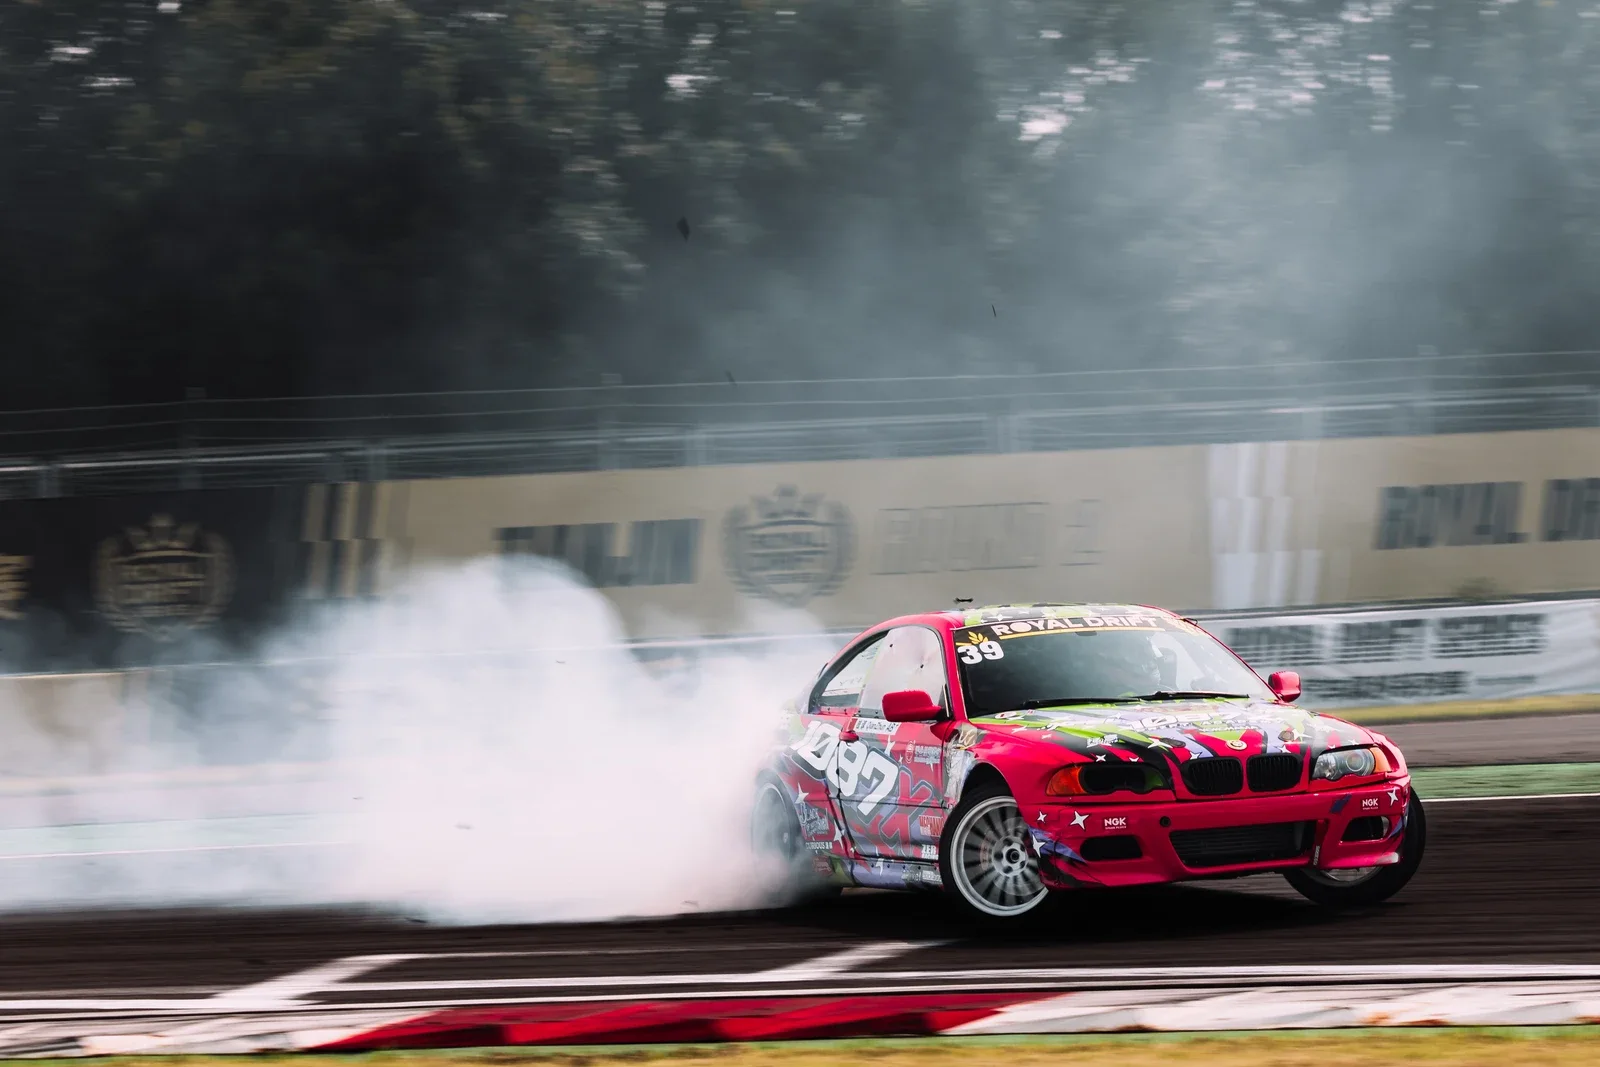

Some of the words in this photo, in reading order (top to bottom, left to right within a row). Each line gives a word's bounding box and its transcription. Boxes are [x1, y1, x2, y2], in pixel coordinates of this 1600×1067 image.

[991, 617, 1084, 636] ROYAL
[1087, 615, 1158, 629] DRIFT
[957, 640, 1004, 665] 39
[1362, 798, 1378, 807] NGK
[1104, 817, 1126, 826] NGK
